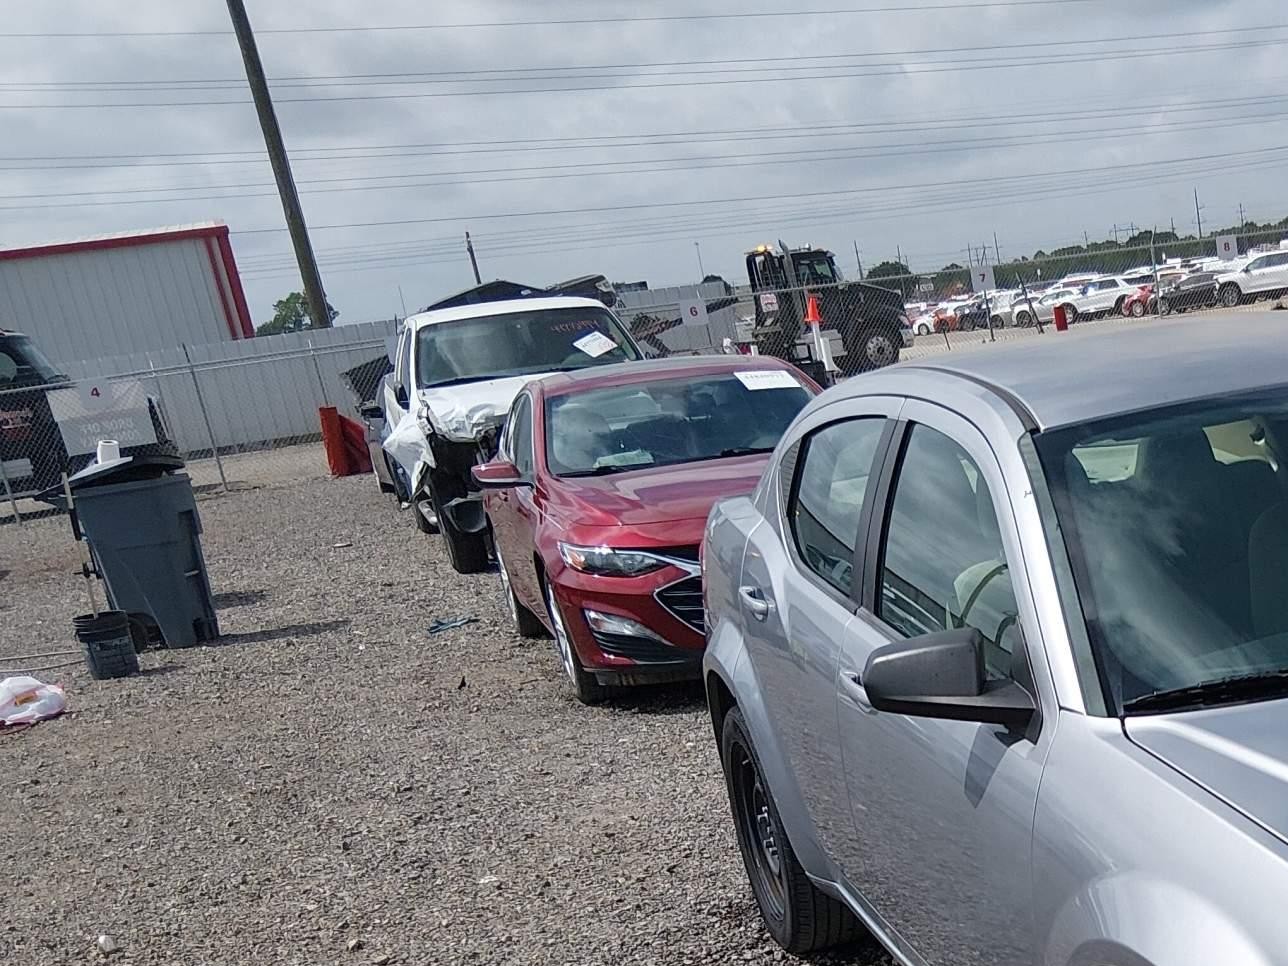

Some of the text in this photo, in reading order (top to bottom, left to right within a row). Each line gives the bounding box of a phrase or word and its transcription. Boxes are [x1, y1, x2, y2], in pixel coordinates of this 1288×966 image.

[1223, 242, 1230, 252] 8
[979, 273, 986, 282] 7
[689, 306, 698, 317] 6
[91, 387, 100, 398] 4
